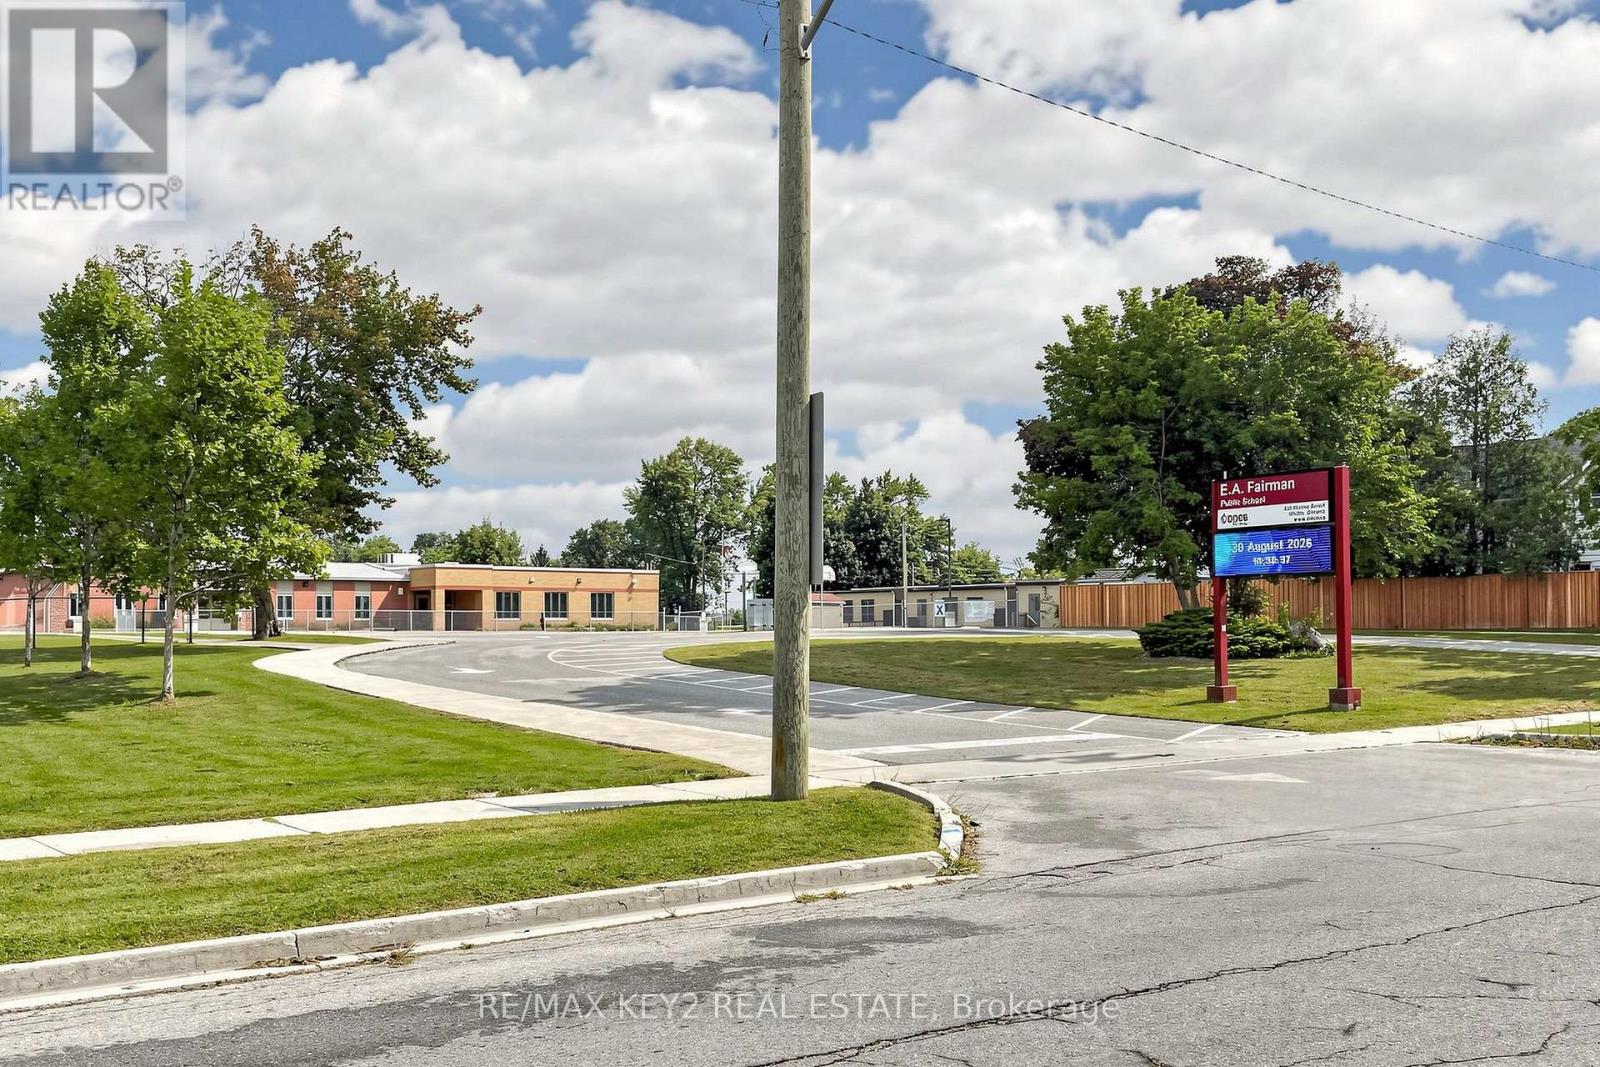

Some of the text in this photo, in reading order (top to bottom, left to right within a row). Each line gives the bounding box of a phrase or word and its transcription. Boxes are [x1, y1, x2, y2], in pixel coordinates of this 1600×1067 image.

[1220, 479, 1295, 496] E.A. Fairman
[1247, 540, 1284, 553] August
